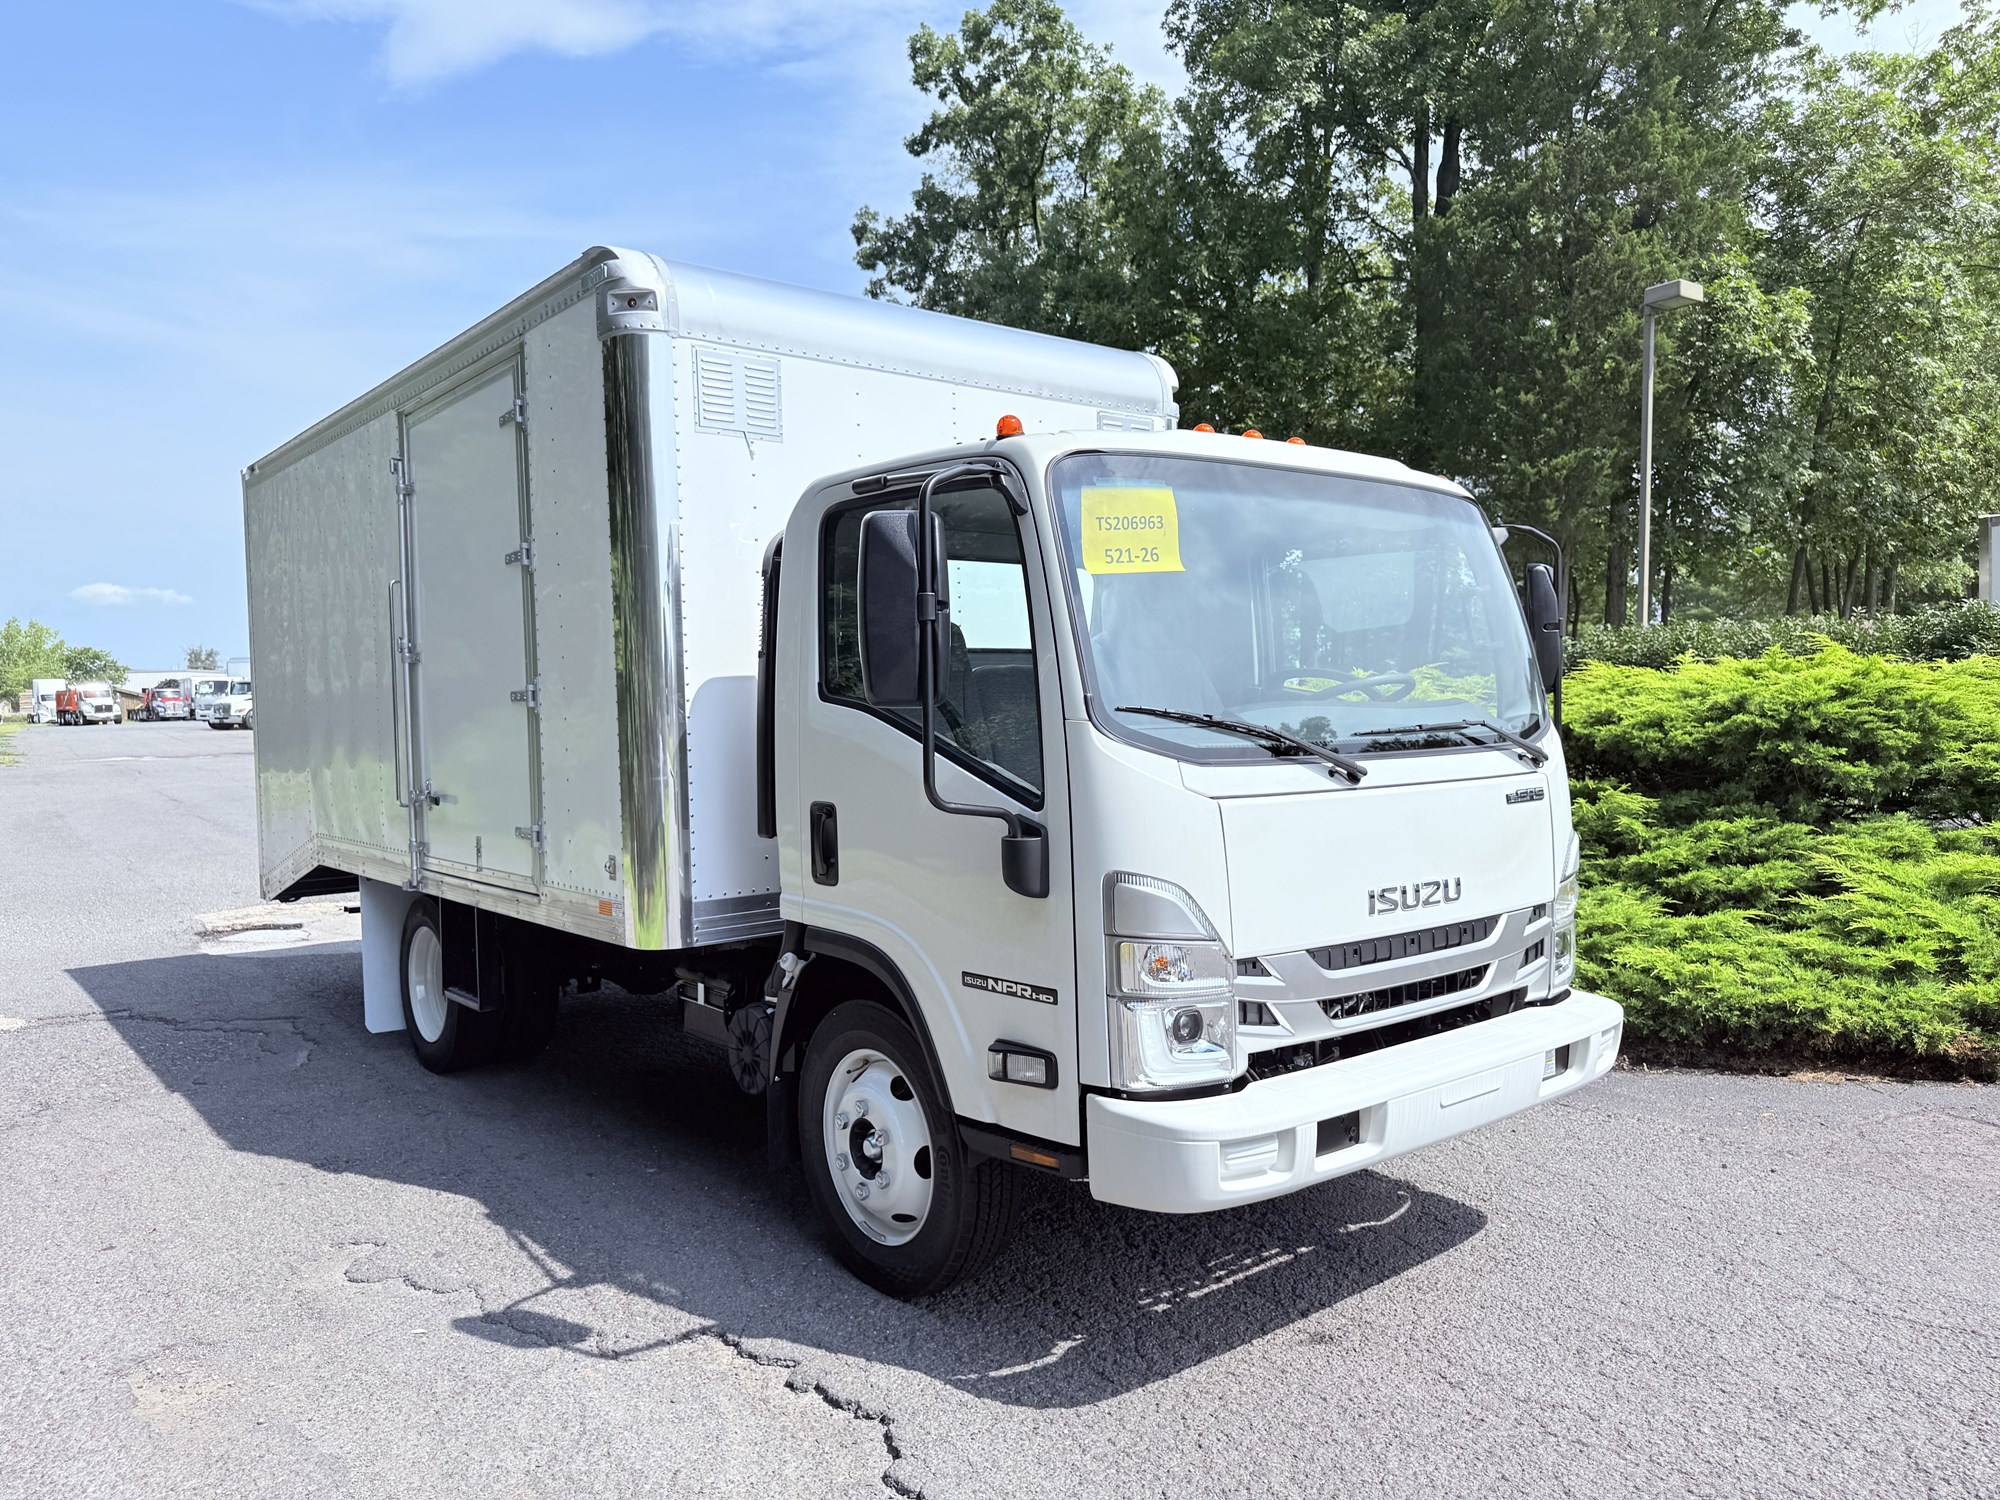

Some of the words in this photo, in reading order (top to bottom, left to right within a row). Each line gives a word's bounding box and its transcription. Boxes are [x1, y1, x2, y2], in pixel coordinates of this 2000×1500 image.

[1095, 515, 1164, 531] TS206963
[1104, 547, 1160, 564] 521-26
[1368, 877, 1461, 917] ISUZU
[964, 975, 987, 987] ISUZU
[987, 978, 1032, 999] NPR
[1032, 992, 1054, 1003] HD
